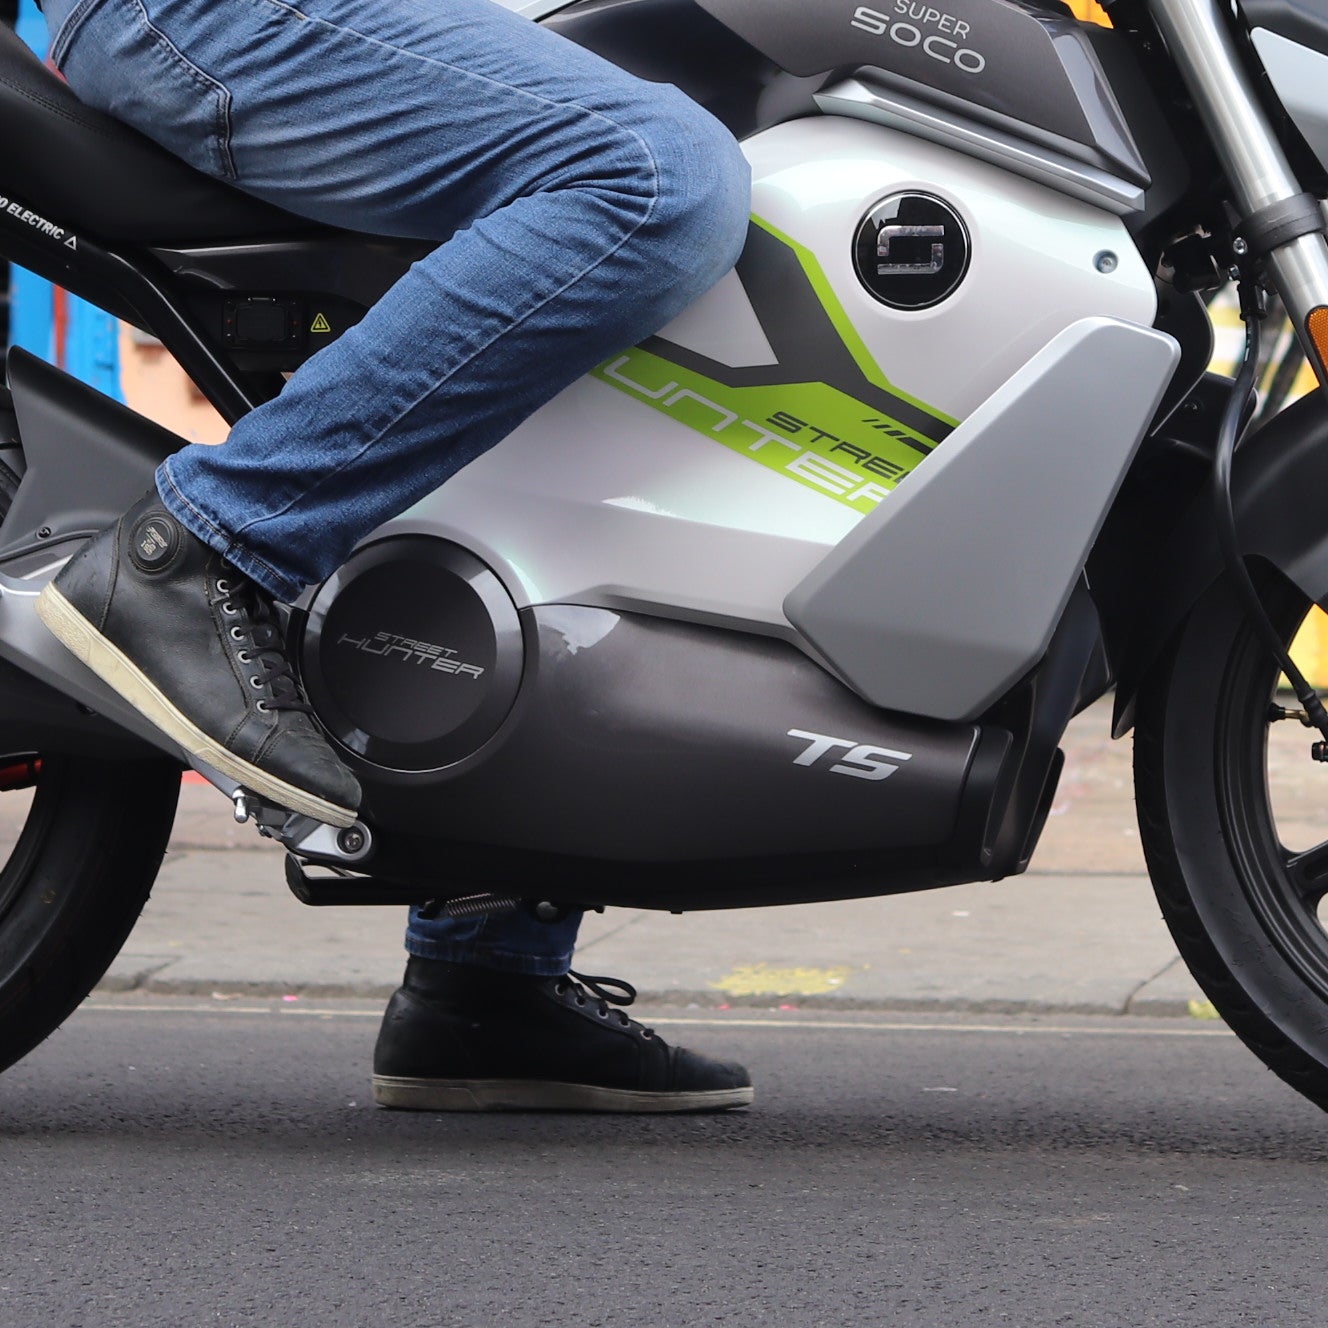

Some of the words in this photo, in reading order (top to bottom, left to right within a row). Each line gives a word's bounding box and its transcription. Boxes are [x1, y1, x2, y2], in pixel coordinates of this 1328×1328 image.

[850, 6, 986, 74] SOCO
[6, 202, 65, 240] ELECTRIC
[765, 410, 911, 485] STRE
[337, 633, 485, 680] HUNTER
[374, 631, 459, 657] STREET
[787, 728, 913, 781] TS
